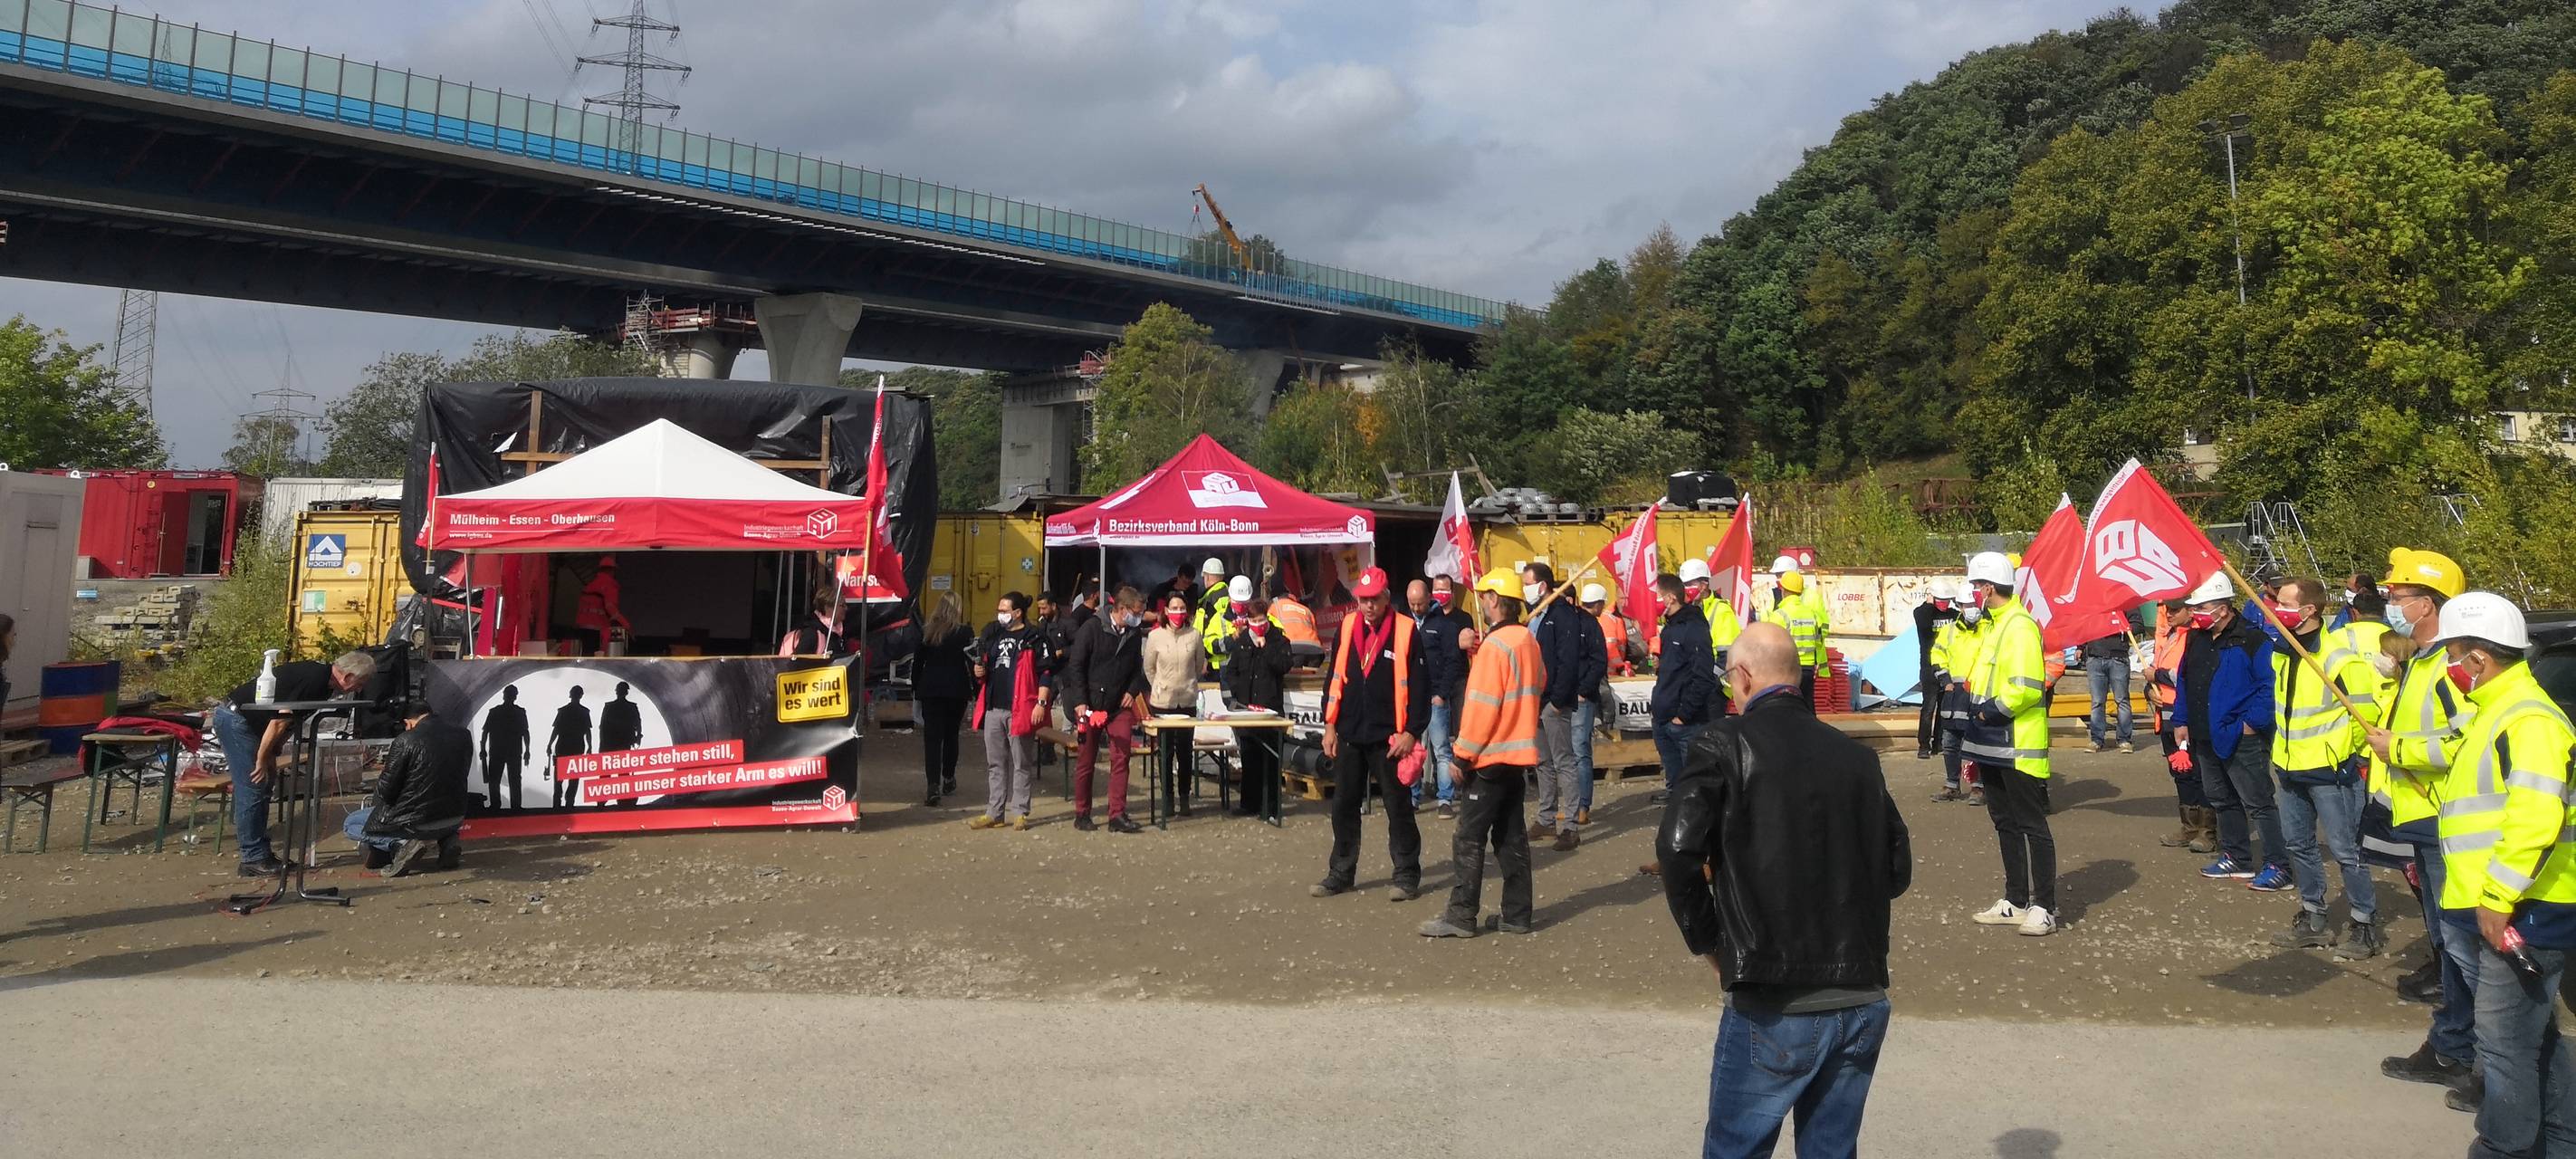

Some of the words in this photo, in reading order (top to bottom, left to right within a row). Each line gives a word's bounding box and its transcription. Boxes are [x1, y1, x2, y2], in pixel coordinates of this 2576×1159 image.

[450, 513, 499, 525] Mülheim
[509, 513, 541, 525] Essen
[551, 513, 615, 525] Oberhausen
[1108, 519, 1196, 532] Bezirksverband
[1200, 519, 1259, 532] Köln-Bonn
[1837, 593, 1865, 601] LOBBE
[783, 681, 809, 695] Wir
[811, 677, 840, 692] sind
[785, 698, 801, 710] es
[808, 692, 841, 708] wert
[567, 758, 598, 774] Alle
[602, 753, 646, 770] Räder
[649, 749, 699, 766] stehen
[703, 743, 734, 760] still,
[588, 781, 630, 797] wenn
[635, 777, 675, 792] unser
[679, 771, 732, 788] starker
[735, 767, 765, 783] Arm
[769, 769, 785, 780] es
[789, 760, 821, 777] will!
